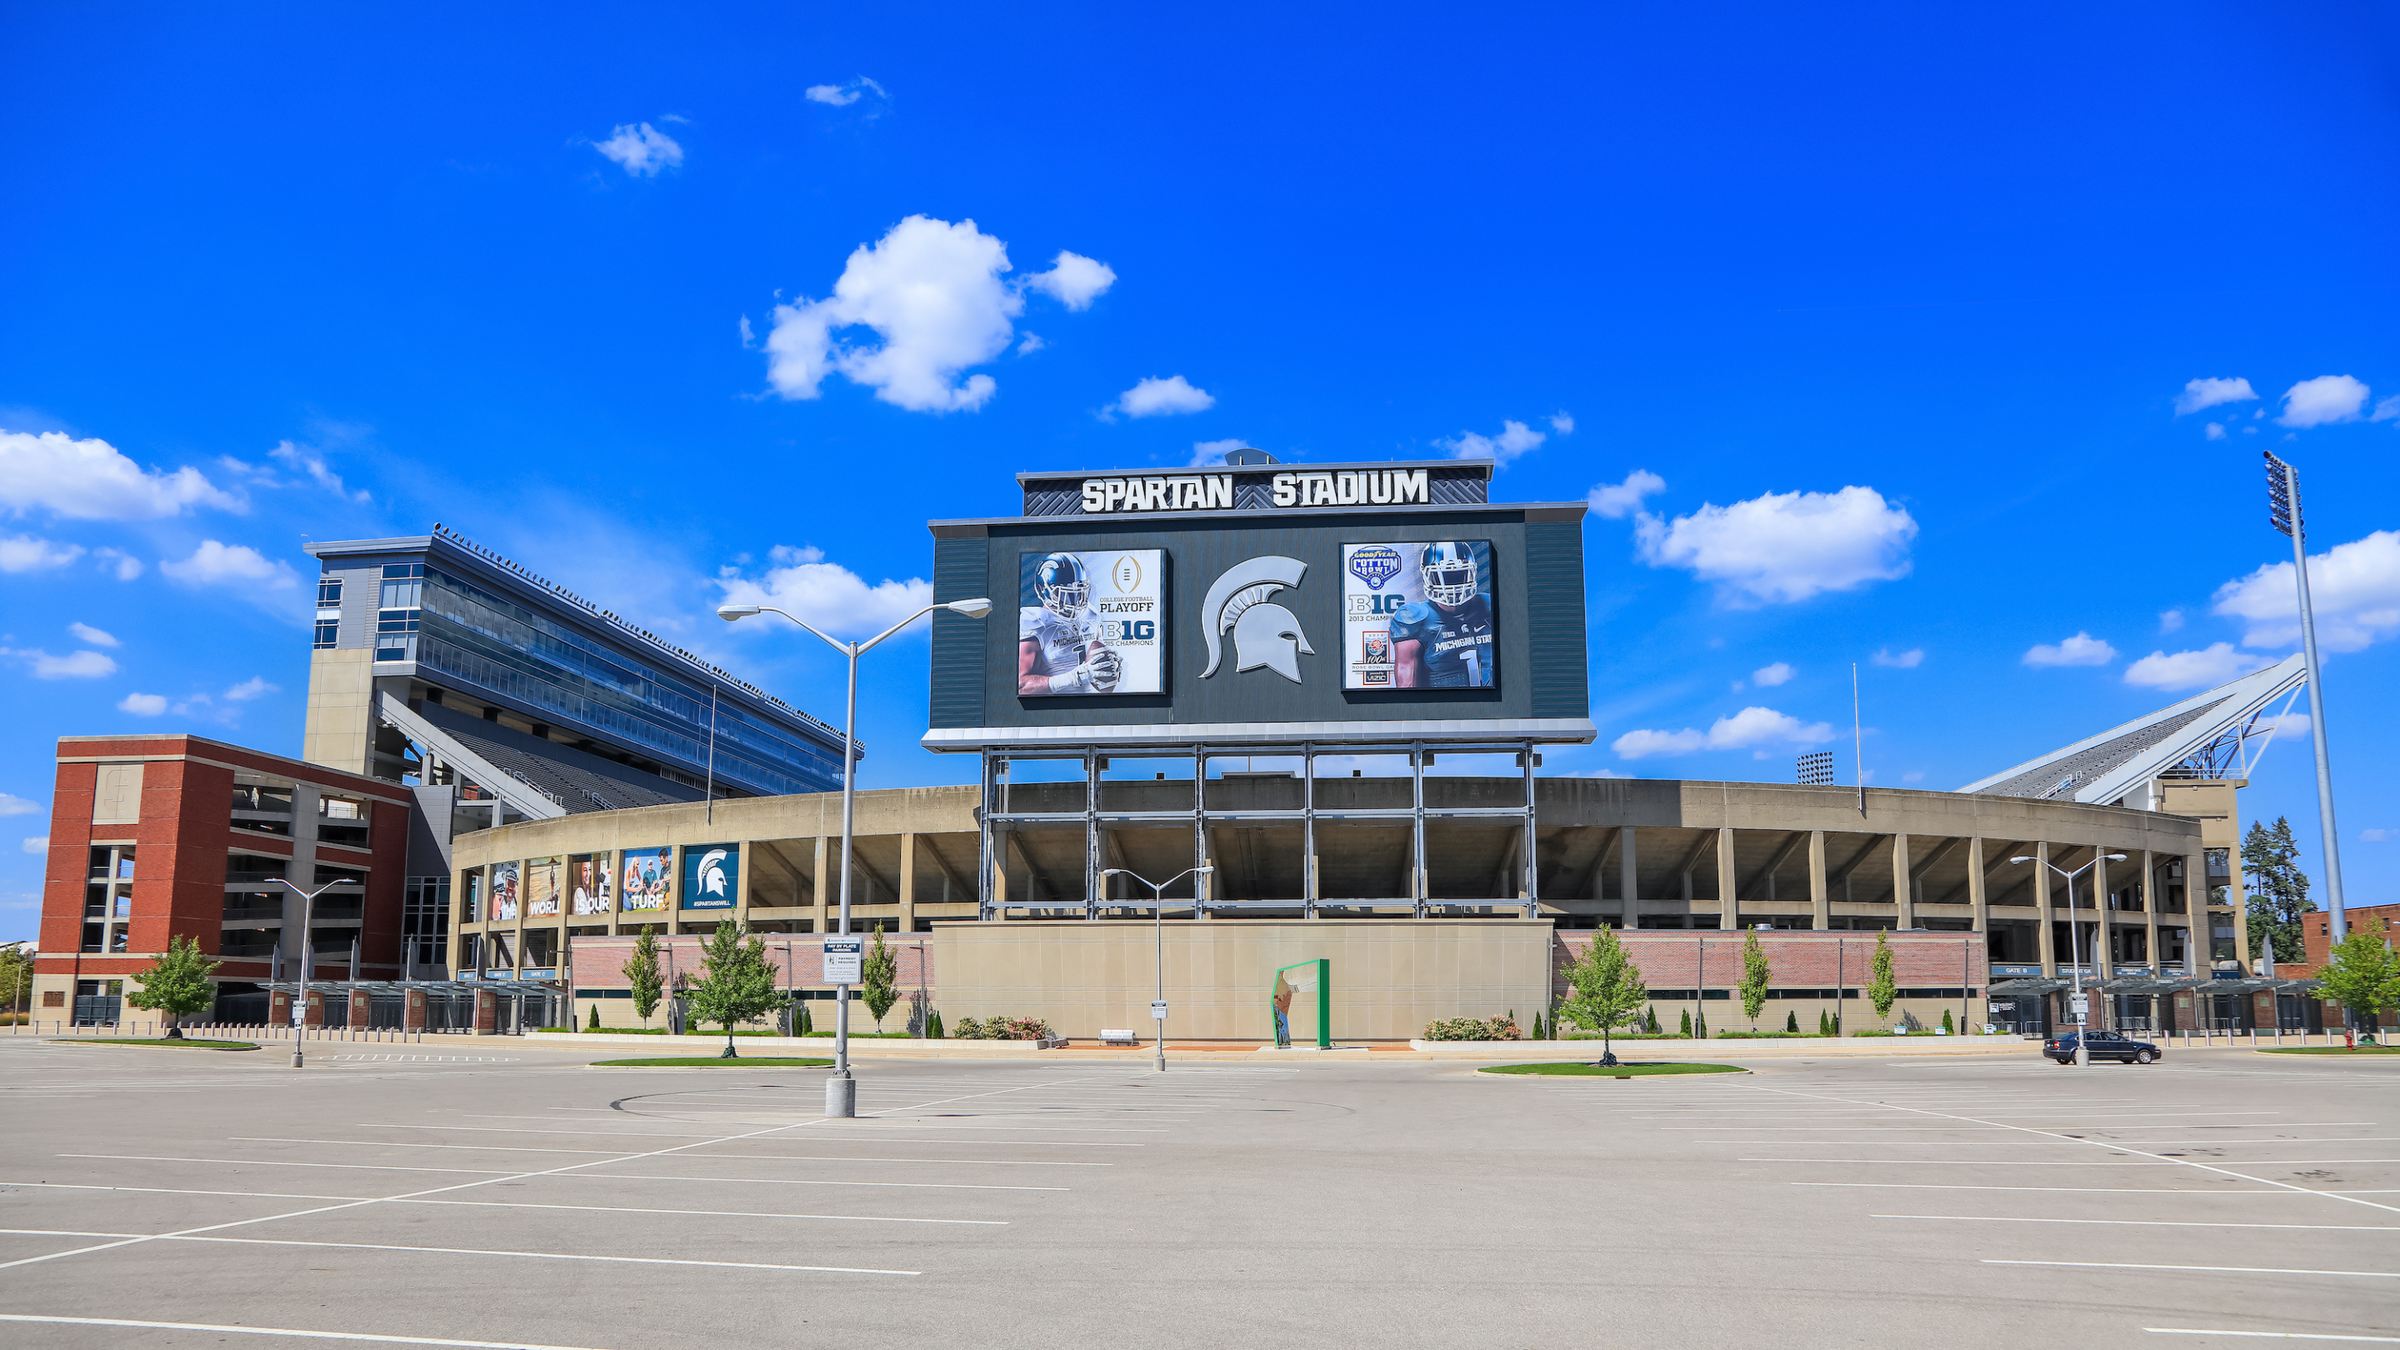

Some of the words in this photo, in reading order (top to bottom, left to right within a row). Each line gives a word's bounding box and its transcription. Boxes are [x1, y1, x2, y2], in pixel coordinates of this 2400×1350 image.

[1082, 475, 1233, 512] SPARTAN
[1273, 469, 1428, 507] STADIUM
[1353, 559, 1398, 572] COTTON
[1361, 567, 1390, 576] BOWL
[1100, 602, 1154, 613] PLAYOFF
[1435, 637, 1476, 652] MICHIGAN
[1459, 649, 1481, 687] 1
[575, 898, 585, 912] IS
[587, 897, 610, 912] OUR
[631, 894, 666, 910] TURF.
